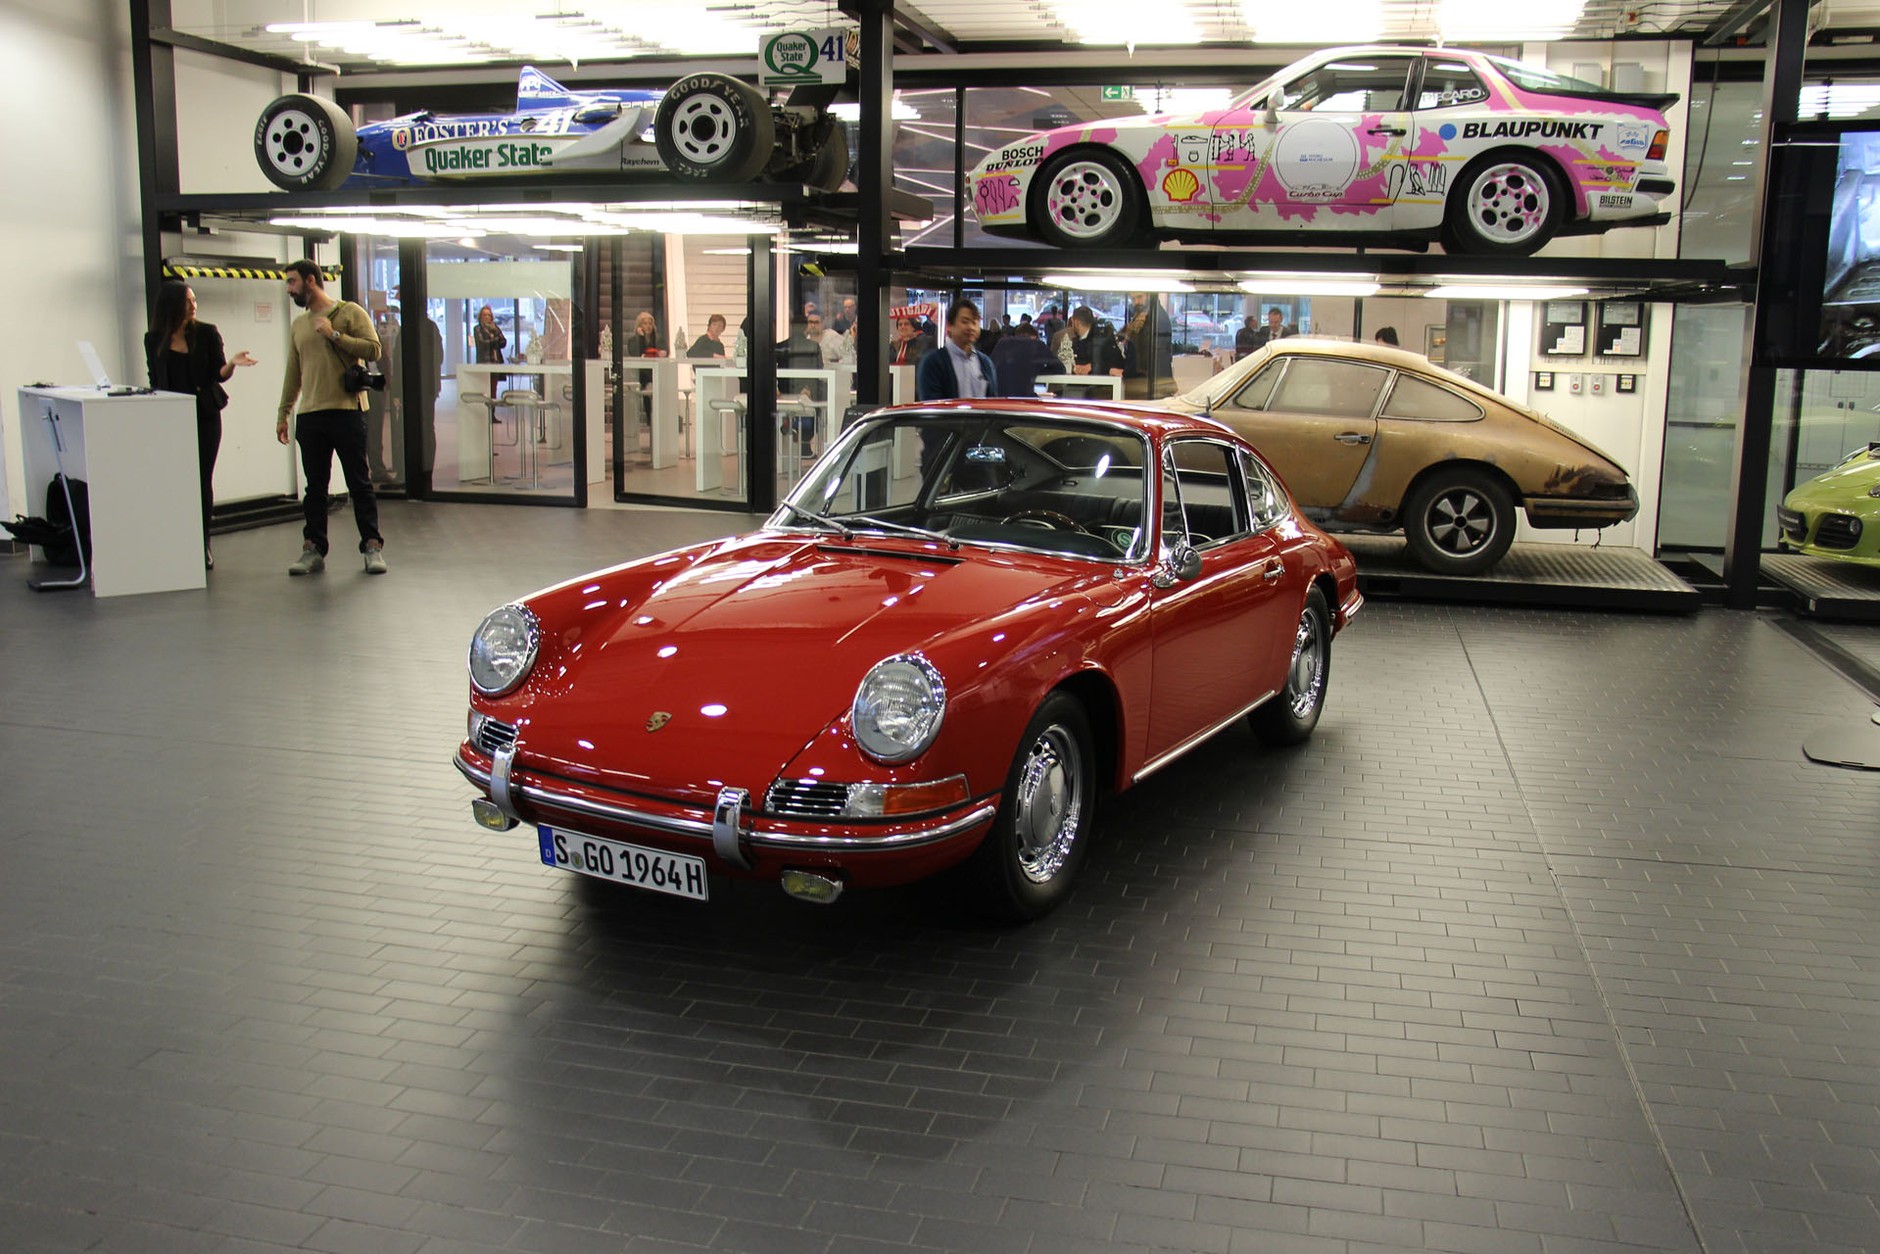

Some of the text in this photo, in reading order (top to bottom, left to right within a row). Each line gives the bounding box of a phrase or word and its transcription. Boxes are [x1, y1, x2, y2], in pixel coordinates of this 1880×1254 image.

[776, 41, 807, 53] Quaker
[820, 35, 844, 62] 41
[780, 52, 804, 62] State
[413, 119, 509, 143] FOSTER'S
[1462, 121, 1604, 140] BLAUPUNKT
[425, 146, 493, 174] Quaker
[1002, 146, 1044, 161] BOSCH
[621, 157, 660, 167] Raychem
[985, 158, 1044, 172] DUNLOP
[1289, 190, 1343, 199] Turbo Cup
[1599, 195, 1633, 205] BILSTEIN
[545, 849, 552, 858] D
[554, 834, 569, 864] S
[583, 841, 614, 875] GO
